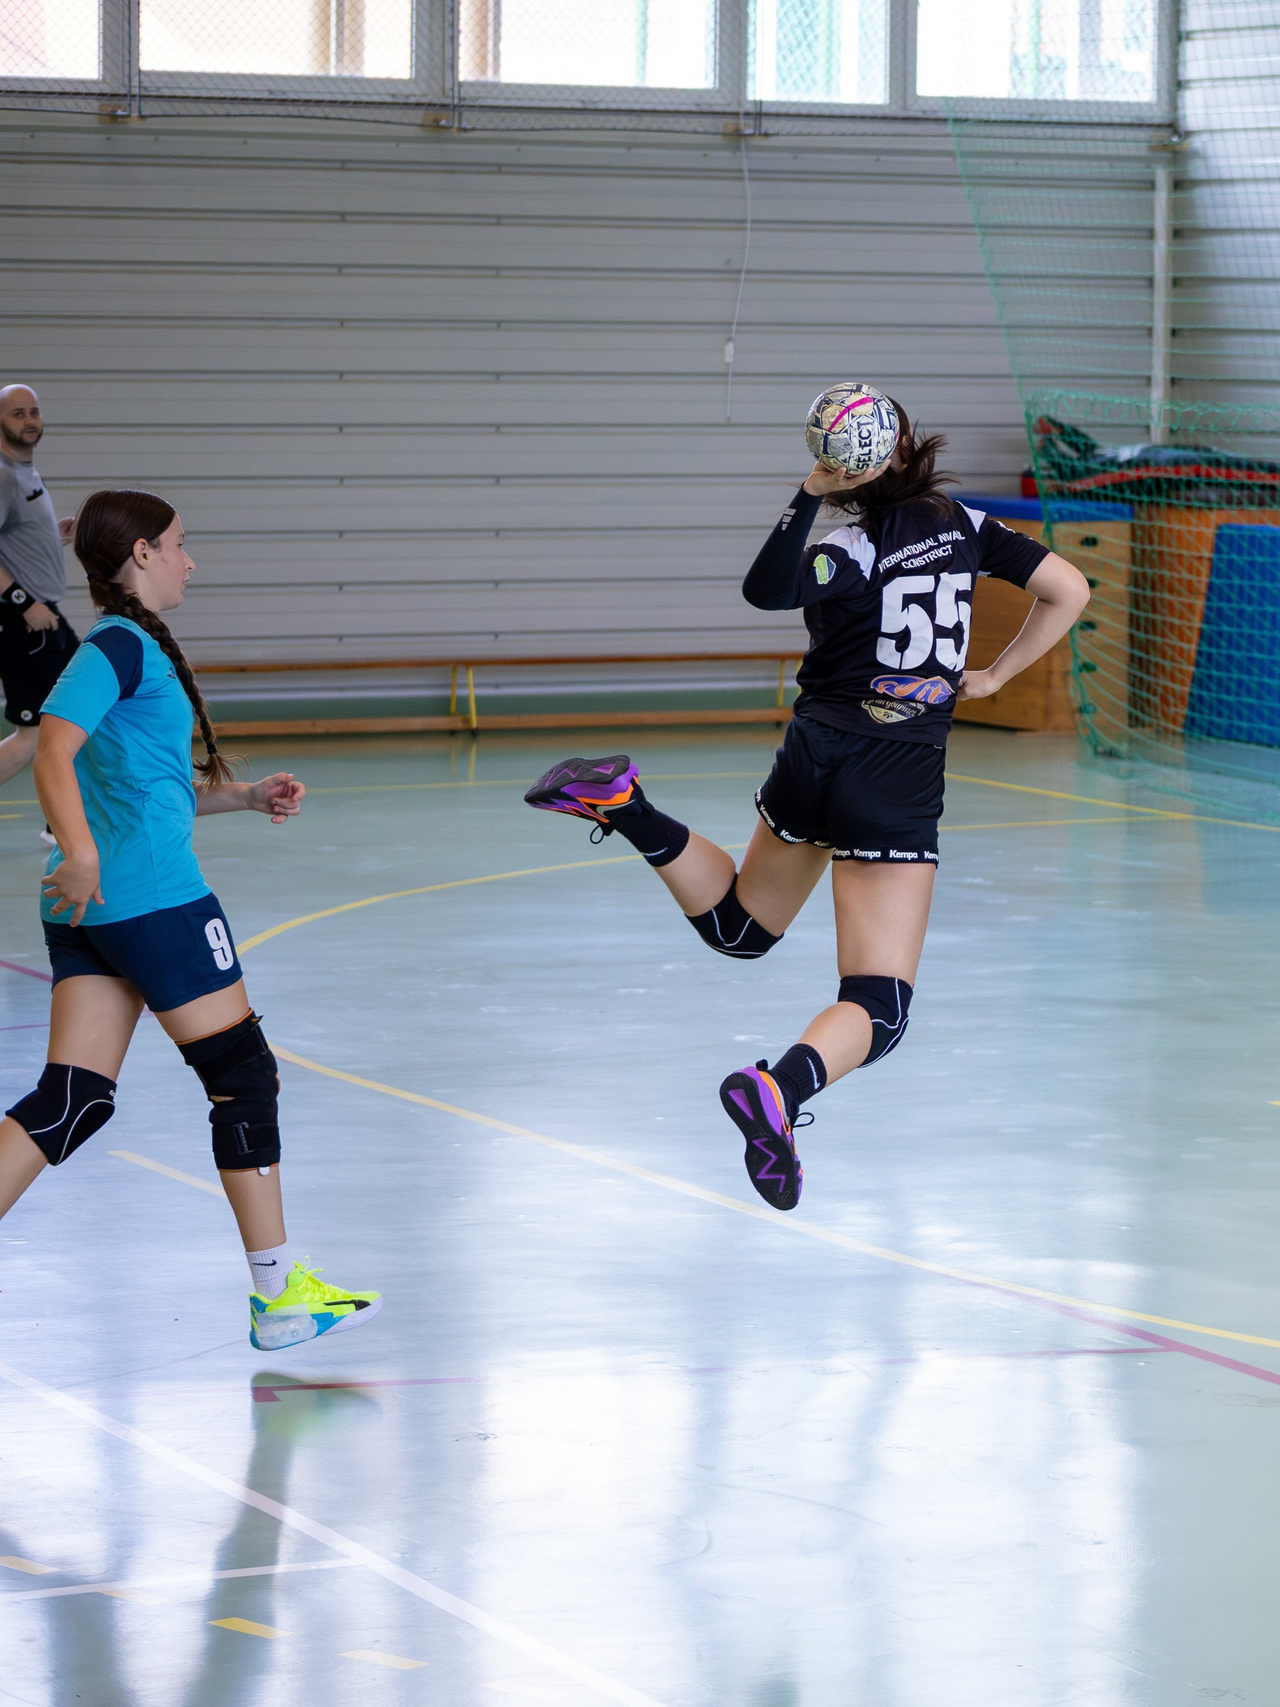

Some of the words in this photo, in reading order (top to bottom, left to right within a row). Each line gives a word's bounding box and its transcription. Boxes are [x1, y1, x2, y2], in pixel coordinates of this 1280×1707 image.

[856, 421, 872, 470] SELECT
[901, 545, 952, 569] CONSTRUCT
[876, 571, 972, 672] 55
[853, 848, 881, 860] Kempa
[889, 849, 918, 860] Kempa
[204, 917, 234, 971] 9
